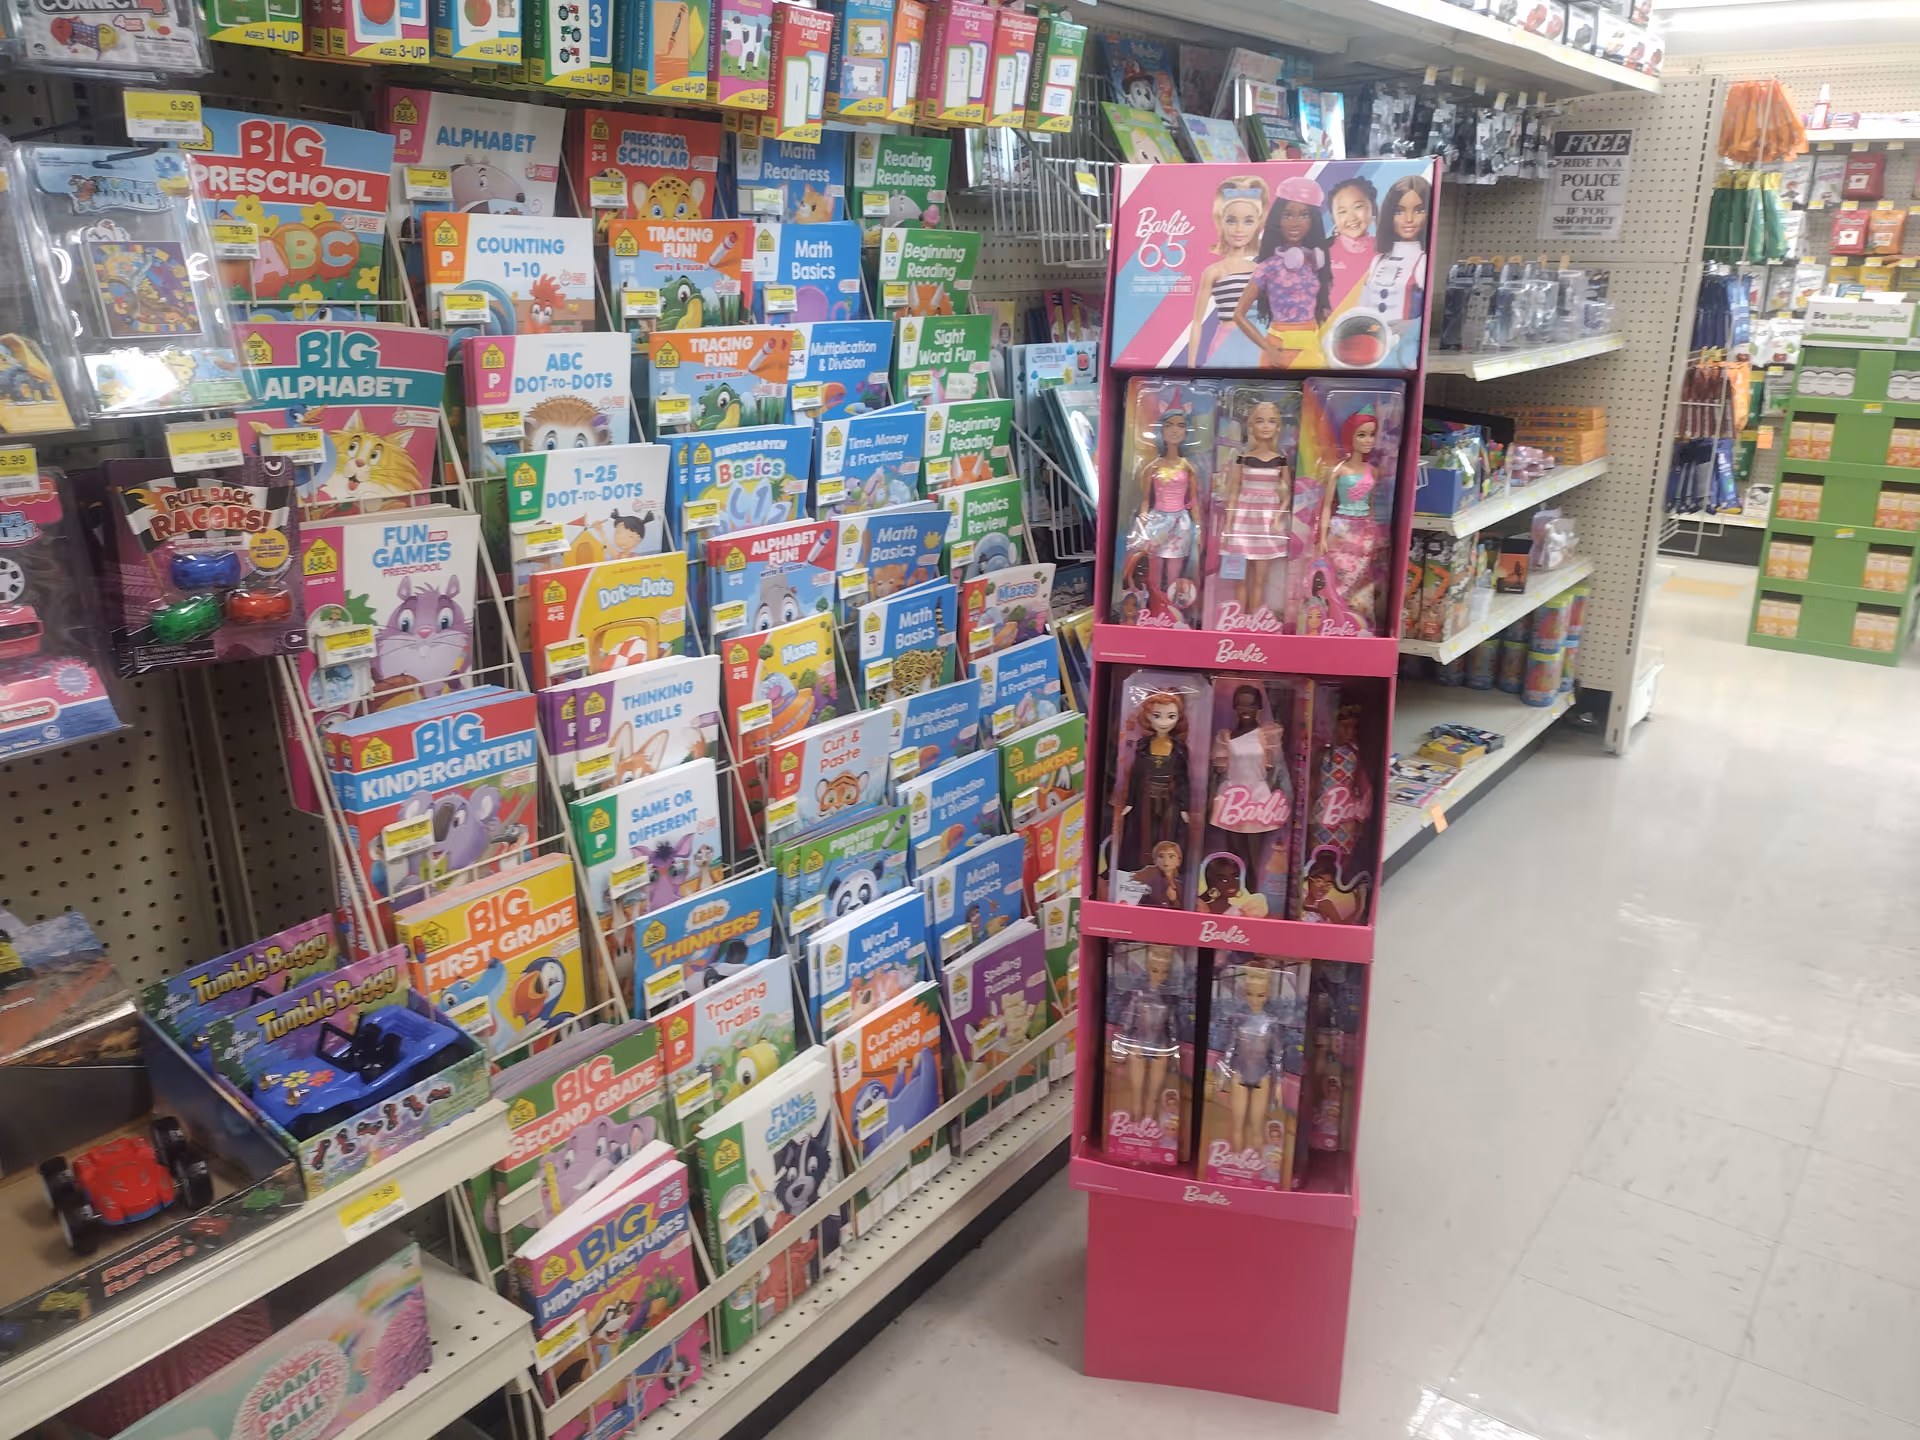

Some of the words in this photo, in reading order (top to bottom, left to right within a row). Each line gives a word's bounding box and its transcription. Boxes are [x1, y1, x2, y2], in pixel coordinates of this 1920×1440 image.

[789, 11, 832, 31] Numbers
[245, 30, 265, 40] AGES
[267, 28, 300, 44] 4-UP
[379, 47, 397, 57] AGES
[398, 42, 427, 58] 3-UP
[495, 44, 520, 58] 4-UP
[770, 30, 782, 81] Numbers
[829, 41, 842, 81] Words
[586, 73, 610, 86] 4-UP
[685, 81, 706, 94] 4-UP
[170, 100, 195, 112] 6.99
[239, 120, 326, 167] BIG
[436, 125, 536, 153] ALPHABET
[623, 130, 686, 149] PRESCHOOL
[779, 140, 815, 159] Math
[1561, 133, 1632, 153] FREE
[618, 146, 689, 169] SCHOLAR
[884, 149, 933, 173] Reading
[1562, 158, 1594, 168] RIDE
[1597, 158, 1610, 168] IN
[1612, 158, 1622, 168] A
[764, 160, 830, 183] Readiness
[876, 168, 936, 188] Readiness
[1560, 173, 1621, 187] POLICE
[194, 165, 372, 203] PRESCHOOL
[1571, 188, 1605, 202] CAR
[1553, 216, 1615, 225] SHOPLIFT
[1566, 207, 1578, 215] IF
[1582, 207, 1608, 215] YOU
[1135, 207, 1195, 239] Barbie
[476, 236, 565, 255] COUNTING
[647, 226, 713, 244] TRACING
[441, 251, 454, 267] P
[662, 242, 698, 259] FUN!
[795, 240, 833, 259] Math
[904, 242, 966, 264] Beginning
[1137, 232, 1186, 268] 65
[503, 261, 541, 278] 1-10
[791, 262, 836, 281] Basics
[884, 256, 897, 267] 1-2
[906, 261, 956, 282] Reading
[1812, 311, 1827, 320] Be
[689, 335, 754, 353] TRACING
[933, 328, 966, 347] Sight
[297, 329, 381, 369] BIG
[704, 350, 739, 369] FUN!
[810, 340, 877, 358] Multiplication
[918, 349, 950, 367] Word
[952, 347, 976, 363] Fun
[546, 353, 583, 372] ABC
[818, 359, 827, 371] &
[828, 356, 866, 371] Division
[264, 374, 413, 402] ALPHABET
[487, 373, 501, 389] P
[515, 372, 613, 394] DOT-TO-DOTS
[948, 415, 1001, 436] Beginning
[209, 431, 234, 443] 1.99
[714, 438, 788, 458] KINDERGARTEN
[848, 437, 874, 451] Time,
[875, 433, 909, 448] Money
[950, 433, 995, 452] Reading
[826, 450, 841, 462] 1-2
[849, 455, 857, 467] &
[858, 450, 904, 466] Fractions
[573, 464, 618, 486] 1-25
[694, 473, 711, 484] 5-6
[718, 458, 785, 488] Basics
[165, 488, 209, 510] PULL
[211, 487, 254, 506] BACK
[520, 490, 533, 507] P
[546, 482, 644, 509] DOT-TO-DOTS
[966, 496, 1010, 520] Phonics
[383, 524, 428, 546] FUN
[877, 525, 918, 544] Math
[967, 516, 1008, 537] Review
[751, 530, 817, 556] ALPHABET
[372, 542, 452, 569] GAMES
[768, 547, 800, 567] FUN!
[870, 544, 916, 565] Basics
[382, 561, 442, 577] PRESCHOOL
[598, 579, 675, 611] Dot-to-Dots
[997, 582, 1039, 605] Mazes
[899, 608, 933, 630] Math
[1137, 609, 1174, 628] Barbie
[1217, 601, 1282, 634] Barbie
[1321, 619, 1356, 637] Barbie
[895, 626, 935, 650] Basics
[781, 640, 818, 666] Mazes
[1215, 638, 1267, 665] Barbie
[621, 680, 694, 711] THINKING
[589, 717, 601, 734] P
[634, 703, 682, 729] SKILLS
[906, 703, 969, 729] Multiplication
[413, 712, 485, 760] BIG
[913, 728, 921, 740] &
[922, 719, 959, 737] Division
[822, 737, 847, 755] Cut
[850, 730, 861, 743] &
[361, 739, 533, 803] KINDERGARTEN
[819, 748, 861, 773] Paste
[1014, 746, 1079, 786] THINKERS
[784, 772, 795, 786] P
[631, 798, 670, 823] SAME
[674, 789, 694, 808] OR
[628, 807, 698, 846] DIFFERENT
[830, 820, 889, 853] PRINTING
[965, 860, 1000, 887] Math
[963, 878, 1003, 906] Basics
[467, 887, 530, 933] BIG
[650, 911, 761, 969] THINKERS
[861, 921, 899, 953] Word
[1199, 920, 1250, 945] Barbie
[425, 940, 494, 987] FIRST
[499, 905, 574, 953] GRADE
[848, 936, 911, 977] Problems
[189, 954, 268, 1005] Tumble
[266, 932, 329, 975] Buggy
[257, 989, 337, 1044] Tumble
[333, 966, 398, 1011] Buggy
[705, 981, 768, 1020] Tracing
[716, 1003, 761, 1039] Trails
[866, 1010, 921, 1052] Cursive
[674, 1039, 685, 1055] P
[869, 1029, 921, 1070] Writing
[555, 1055, 616, 1104] BIG
[510, 1103, 592, 1160] SECOND
[596, 1065, 656, 1113] GRADE
[770, 1095, 801, 1124] FUN
[765, 1101, 818, 1144] GAMES
[1109, 1111, 1163, 1139] Barbie
[1208, 1140, 1266, 1171] Barbie
[1182, 1185, 1232, 1206] Barbie
[577, 1204, 649, 1271] BIG
[541, 1266, 606, 1319] HIDDEN
[607, 1213, 686, 1280] PICTURES
[260, 1358, 322, 1413] GIANT
[269, 1395, 326, 1440] BALL
